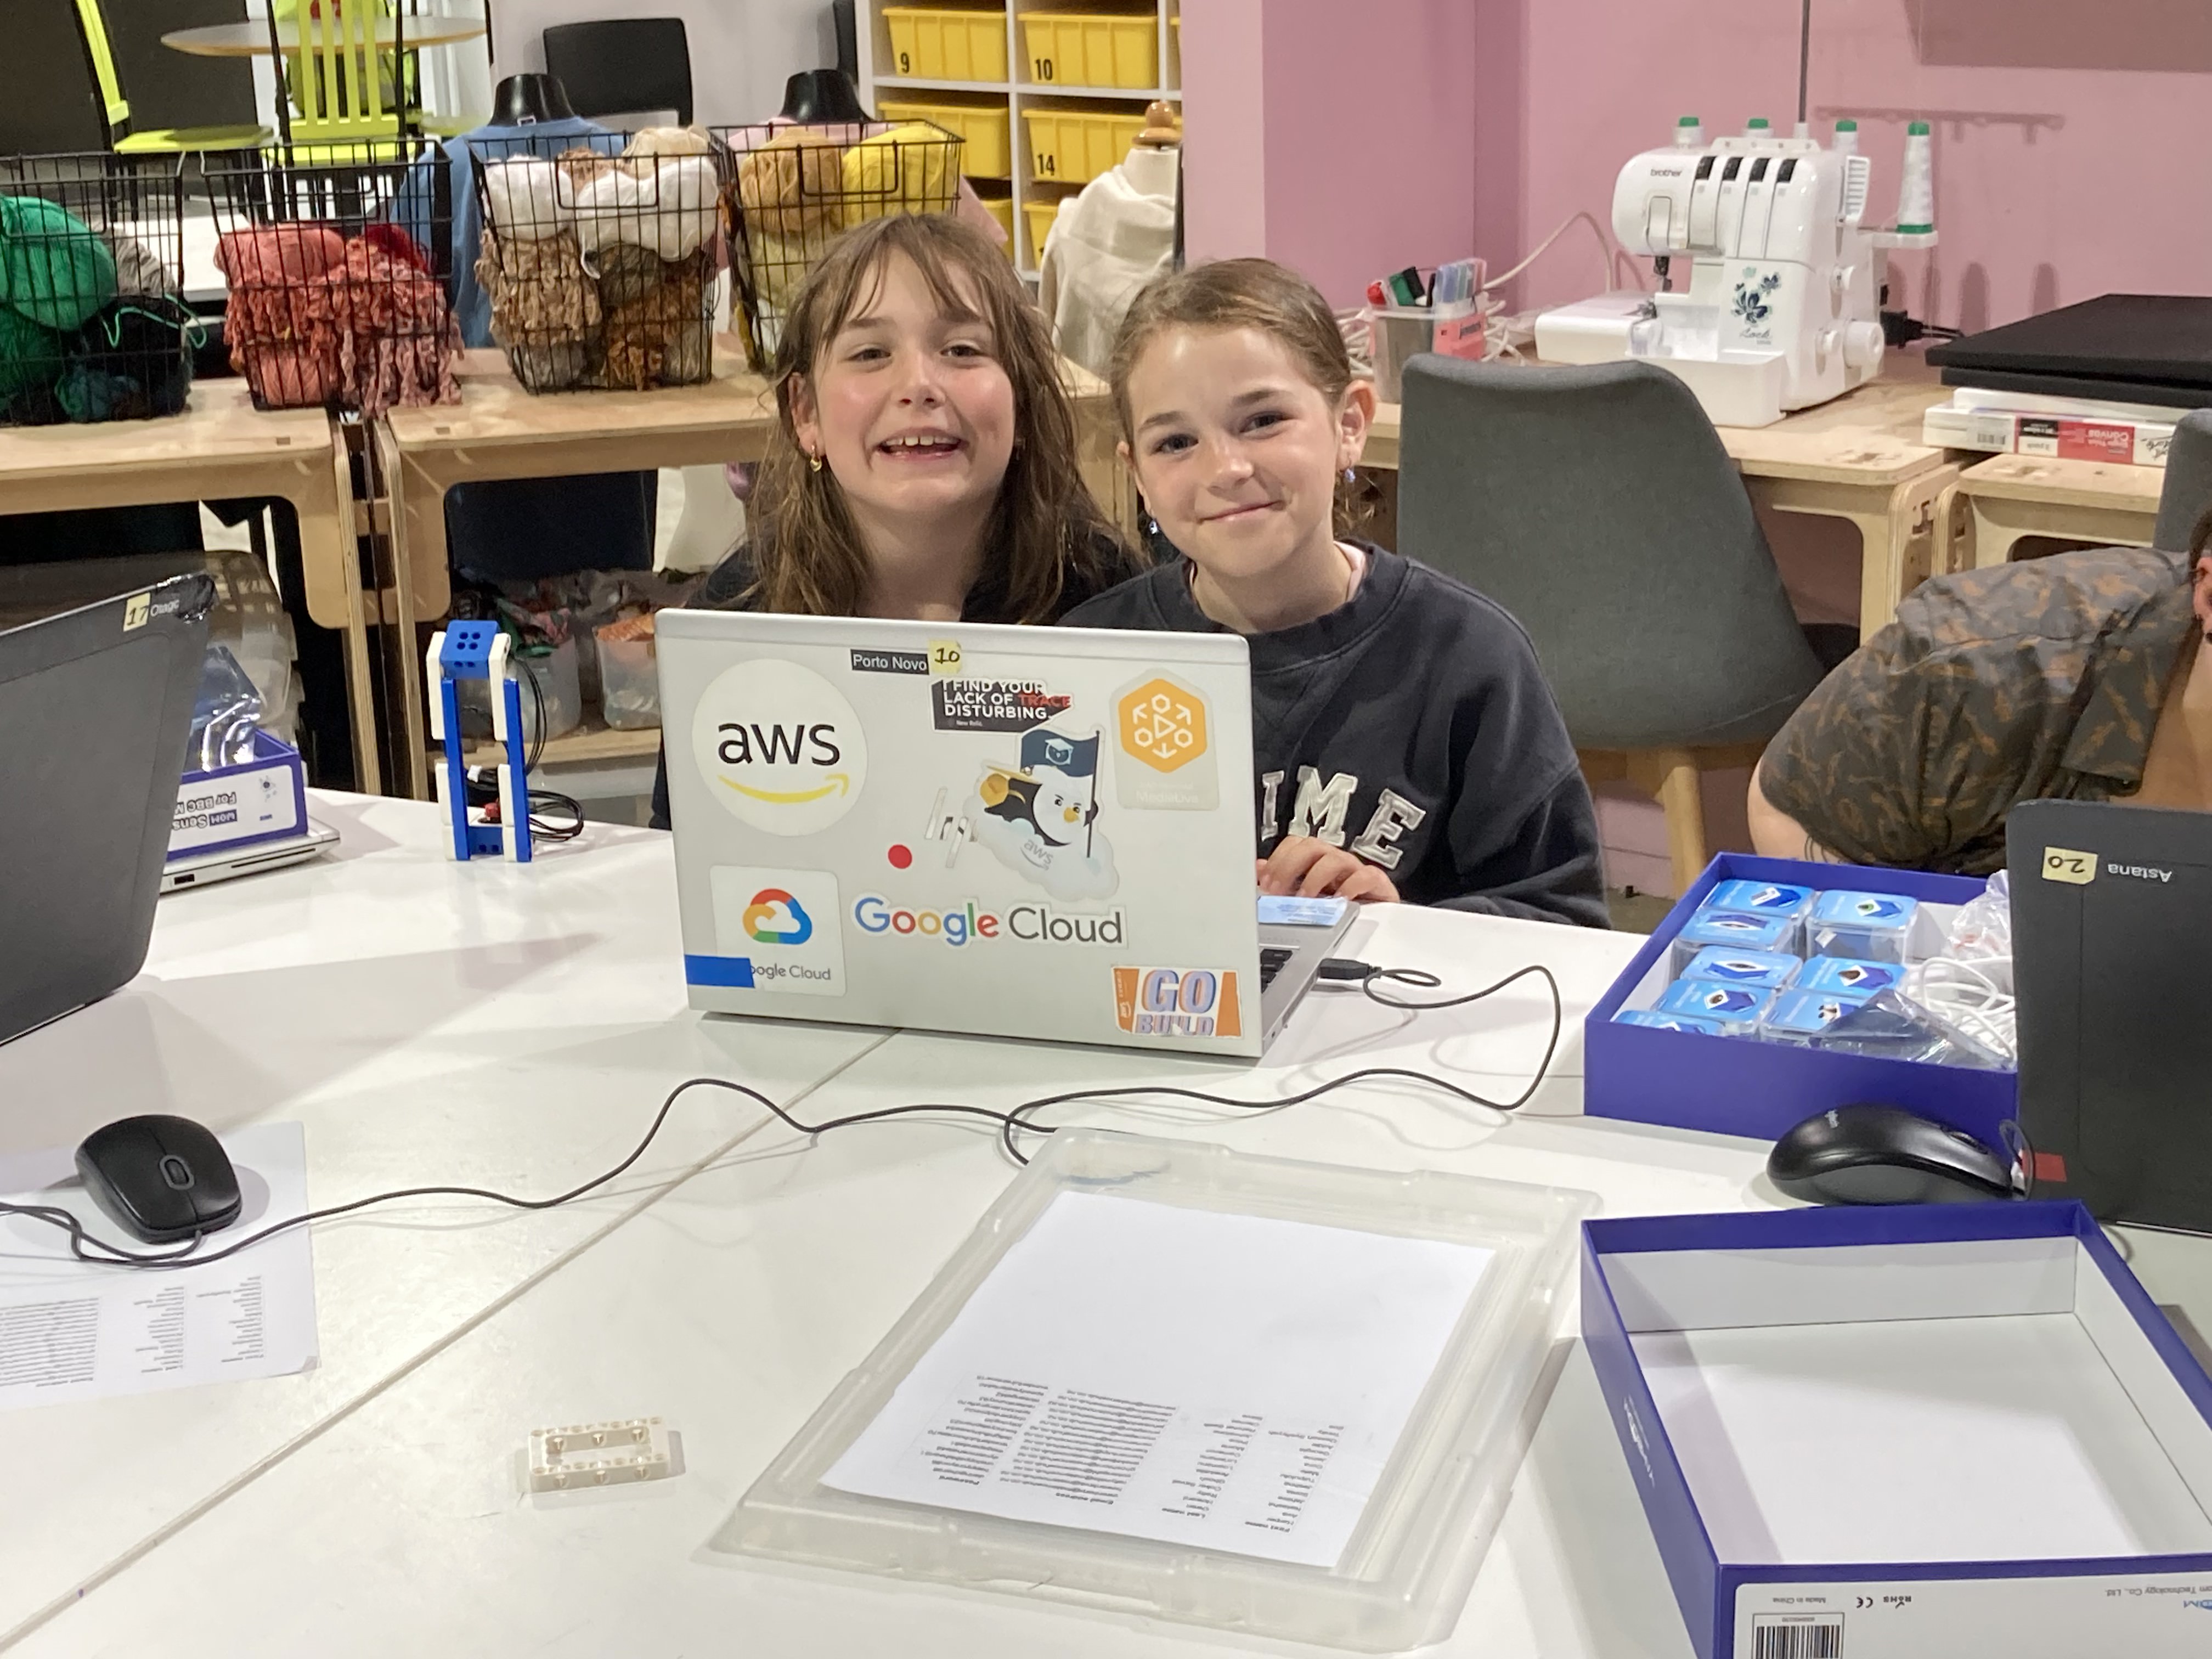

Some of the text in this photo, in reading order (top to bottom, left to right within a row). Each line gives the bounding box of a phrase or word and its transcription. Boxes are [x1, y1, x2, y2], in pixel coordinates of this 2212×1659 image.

[900, 52, 910, 74] 9
[1035, 59, 1053, 81] 10
[1037, 154, 1055, 176] 14
[126, 606, 149, 626] 17
[853, 653, 927, 672] Porto Novo
[934, 648, 960, 664] 10
[953, 680, 992, 692] FIND
[998, 681, 1046, 694] YOUR
[944, 692, 1071, 708] LACK OF TRACE
[945, 705, 1052, 720] DISTURBING.
[718, 723, 840, 766] aws
[186, 796, 213, 812] BBC
[215, 792, 236, 805] For
[1023, 839, 1054, 865] aws
[2048, 856, 2085, 874] 20
[2107, 864, 2172, 883] Astana
[855, 896, 1122, 946] Google Cloud
[751, 963, 831, 981] oogle Cloud
[1141, 969, 1217, 1014] GO
[2105, 1589, 2121, 1597] Ltd.
[2145, 1586, 2197, 1596] Technology
[1856, 1596, 1874, 1609] CE
